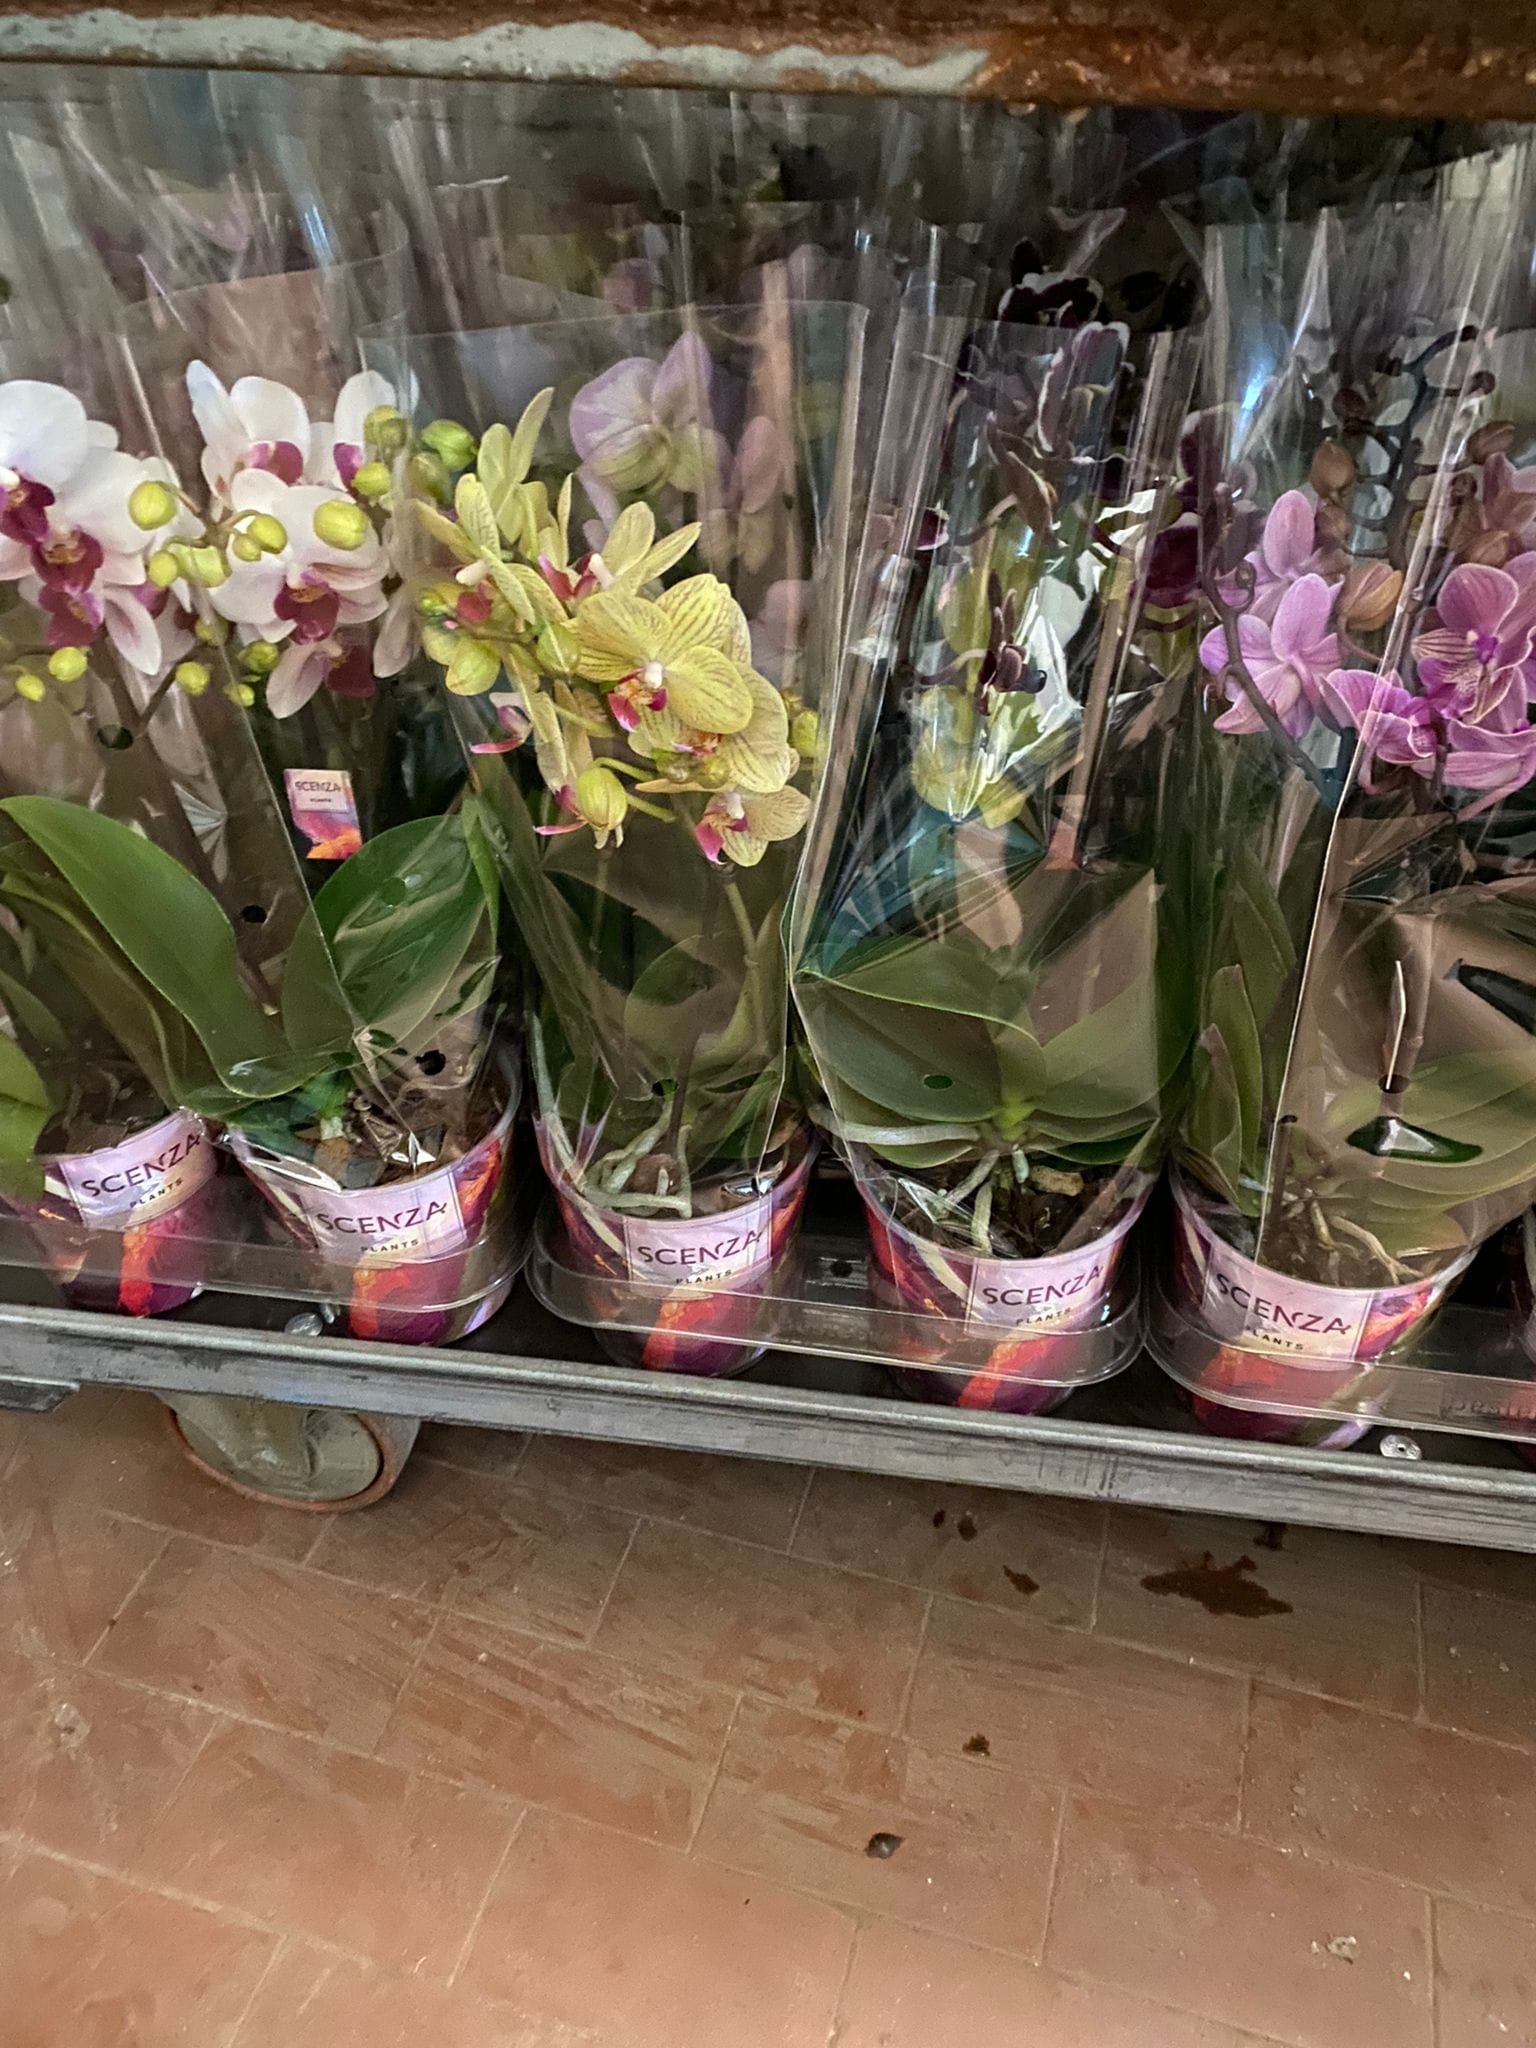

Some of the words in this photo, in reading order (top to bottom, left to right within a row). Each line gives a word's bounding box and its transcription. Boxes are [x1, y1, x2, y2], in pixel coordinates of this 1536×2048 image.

[294, 781, 341, 792] SCENZA
[81, 1134, 201, 1197] SCENZA
[130, 1178, 184, 1208] PLANTS
[317, 1201, 448, 1235] SCENZA
[360, 1238, 420, 1253] PLANTS
[637, 1230, 763, 1265] SCENZA
[676, 1269, 733, 1284] PLANTS
[982, 1265, 1104, 1306] SCENZA
[1016, 1306, 1072, 1326] PLANTS
[1216, 1273, 1352, 1335] SCENZA
[1247, 1326, 1304, 1350] LANTS
